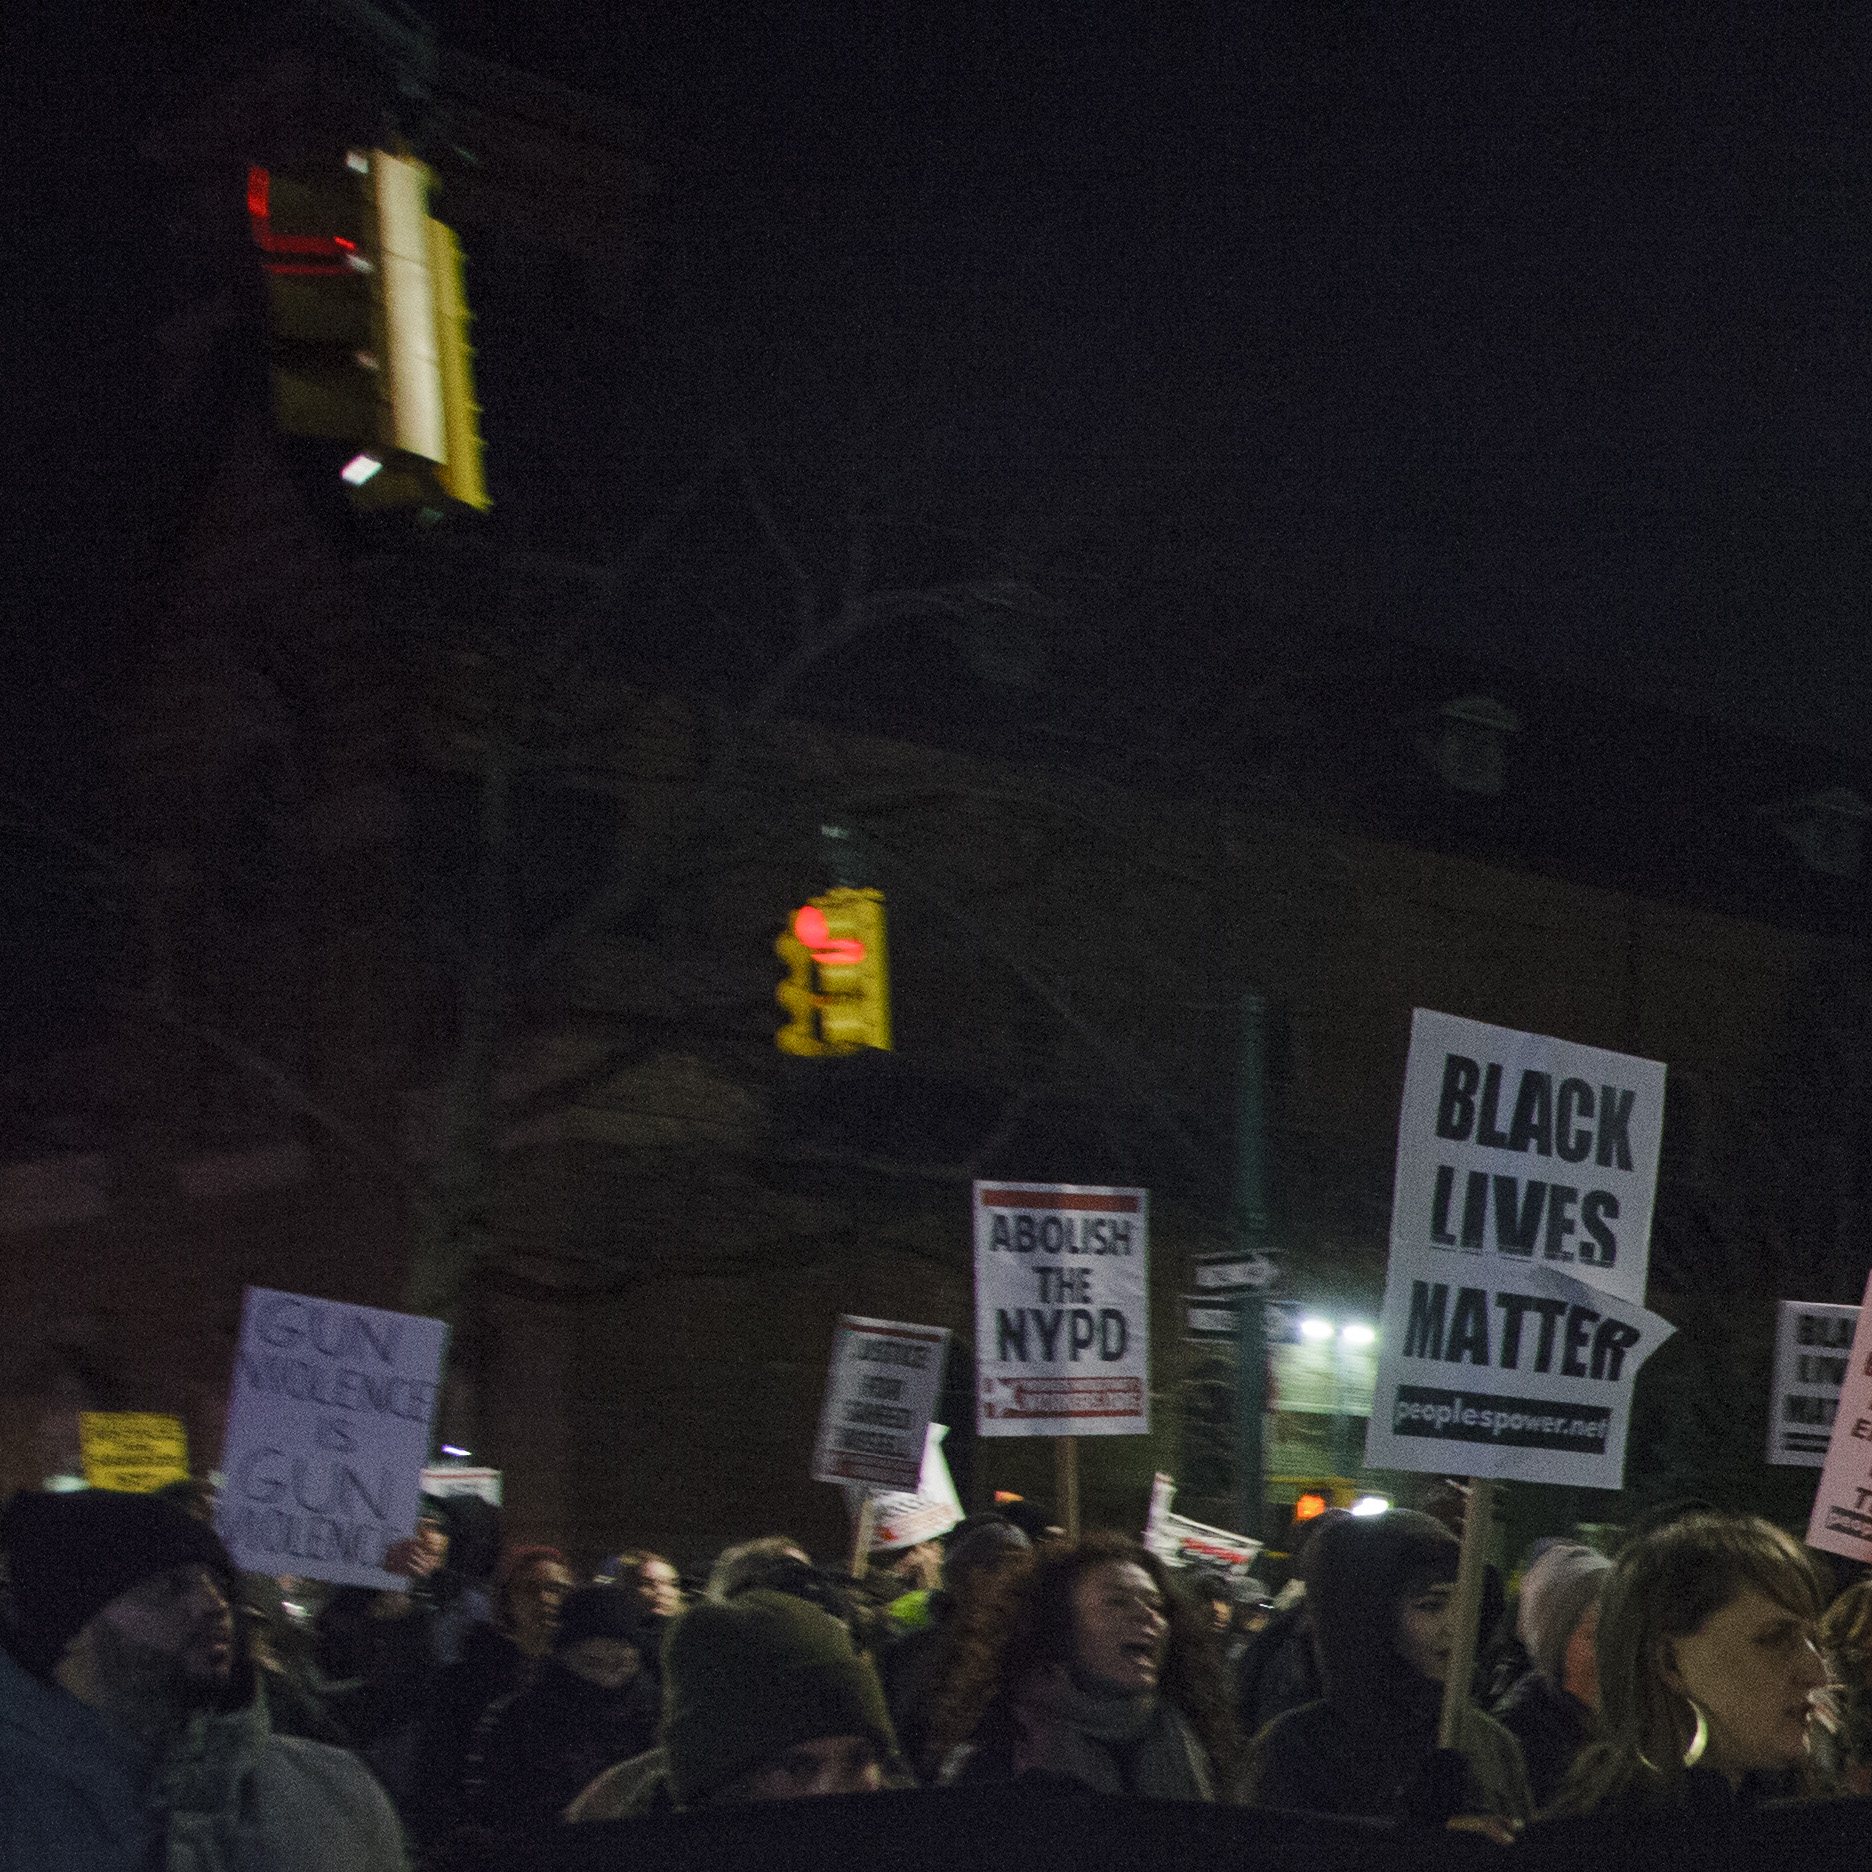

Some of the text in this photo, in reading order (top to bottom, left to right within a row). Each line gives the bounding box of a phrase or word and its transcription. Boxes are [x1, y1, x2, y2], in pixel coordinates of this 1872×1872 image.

[1436, 1053, 1638, 1173] BLACK
[989, 1214, 1134, 1257] ABOLISH
[1430, 1165, 1622, 1269] LIVES
[1031, 1265, 1093, 1305] THE
[255, 1297, 405, 1365] GUN
[997, 1308, 1128, 1362] NYPD
[1402, 1279, 1641, 1382] MATTER
[1394, 1397, 1608, 1441] peoplespower.net
[237, 1445, 396, 1521] GUN
